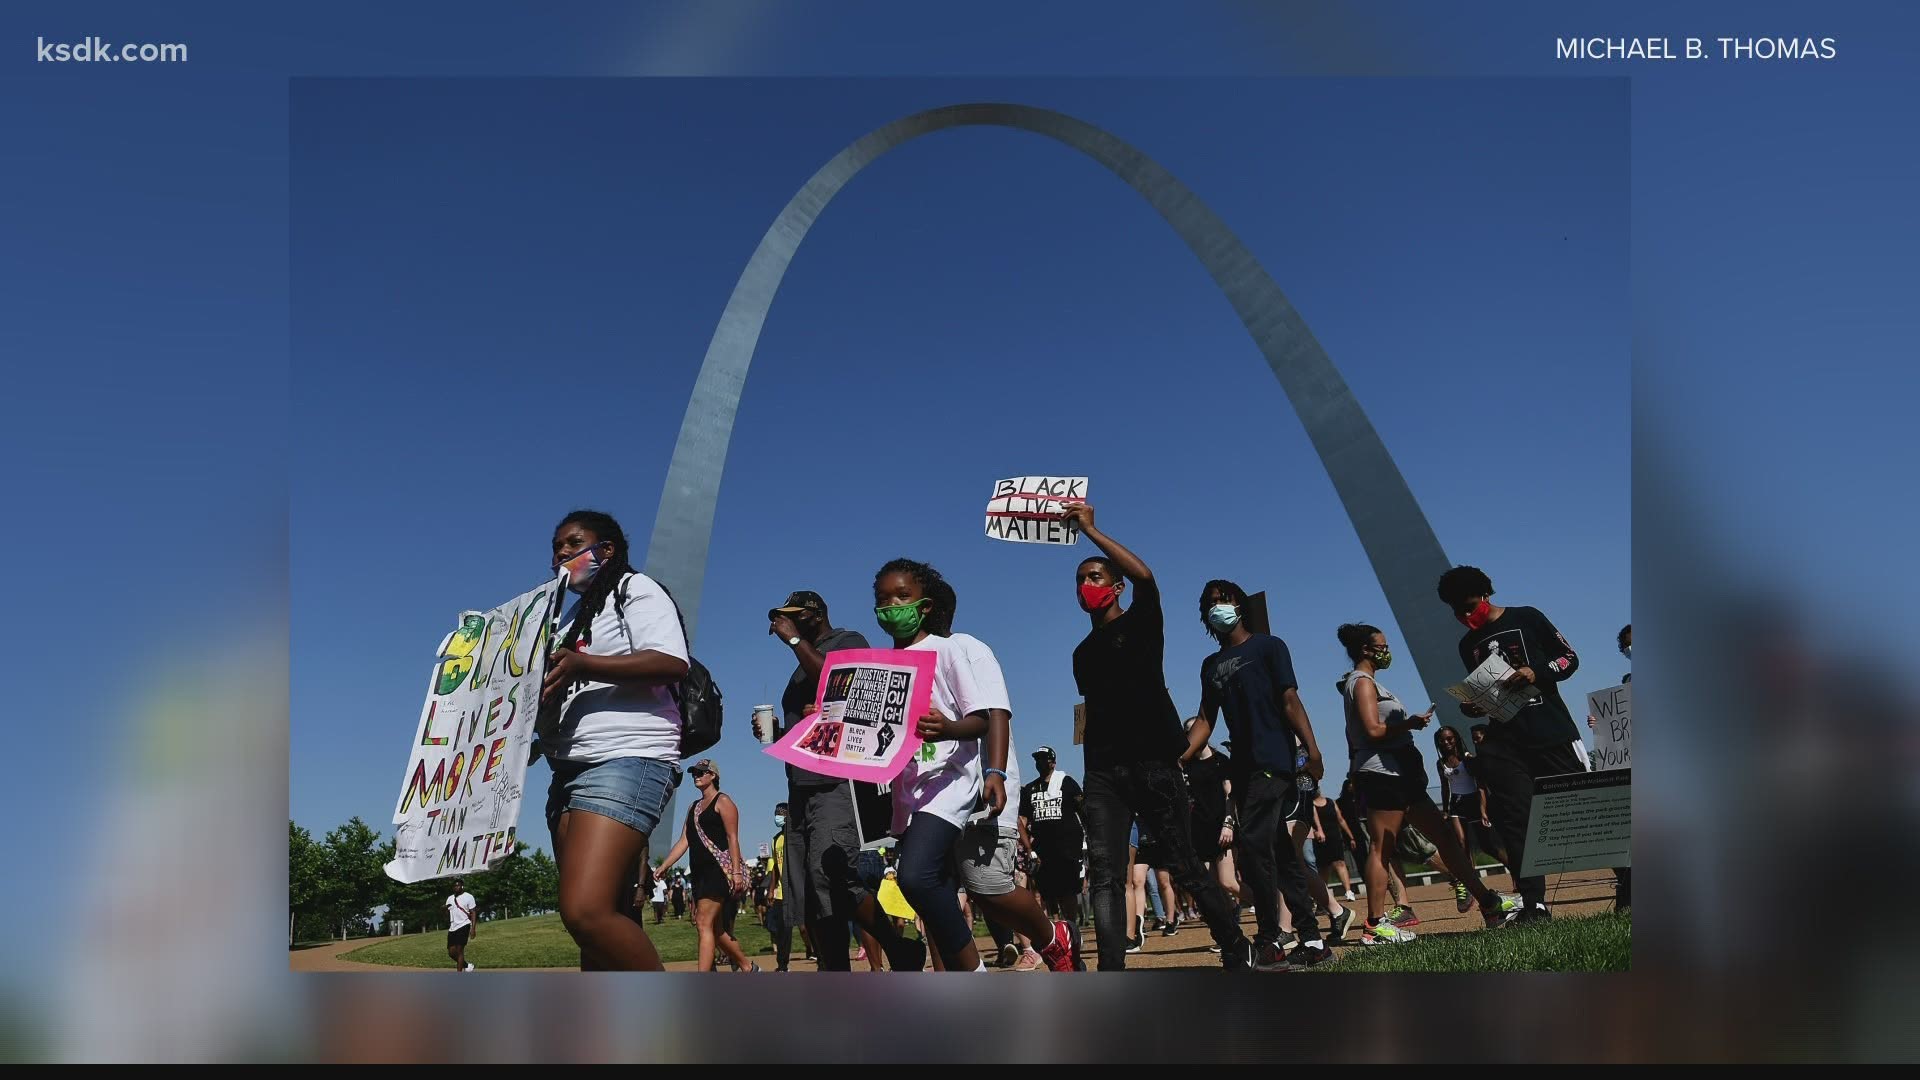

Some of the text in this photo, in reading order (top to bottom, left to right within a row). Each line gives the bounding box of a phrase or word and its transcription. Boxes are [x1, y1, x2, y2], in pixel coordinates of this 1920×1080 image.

[997, 477, 1084, 498] BLACK
[855, 668, 888, 682] INJUSTICE
[852, 680, 886, 692] ANYWHERE
[860, 690, 883, 702] THREAT
[855, 699, 881, 713] JUSTICE
[1592, 689, 1627, 718] WE
[421, 682, 520, 751] LIVES
[844, 709, 878, 722] EVERYWHERE
[400, 737, 507, 814] MORE
[427, 807, 468, 836] THAN
[437, 826, 517, 875] MATTER
